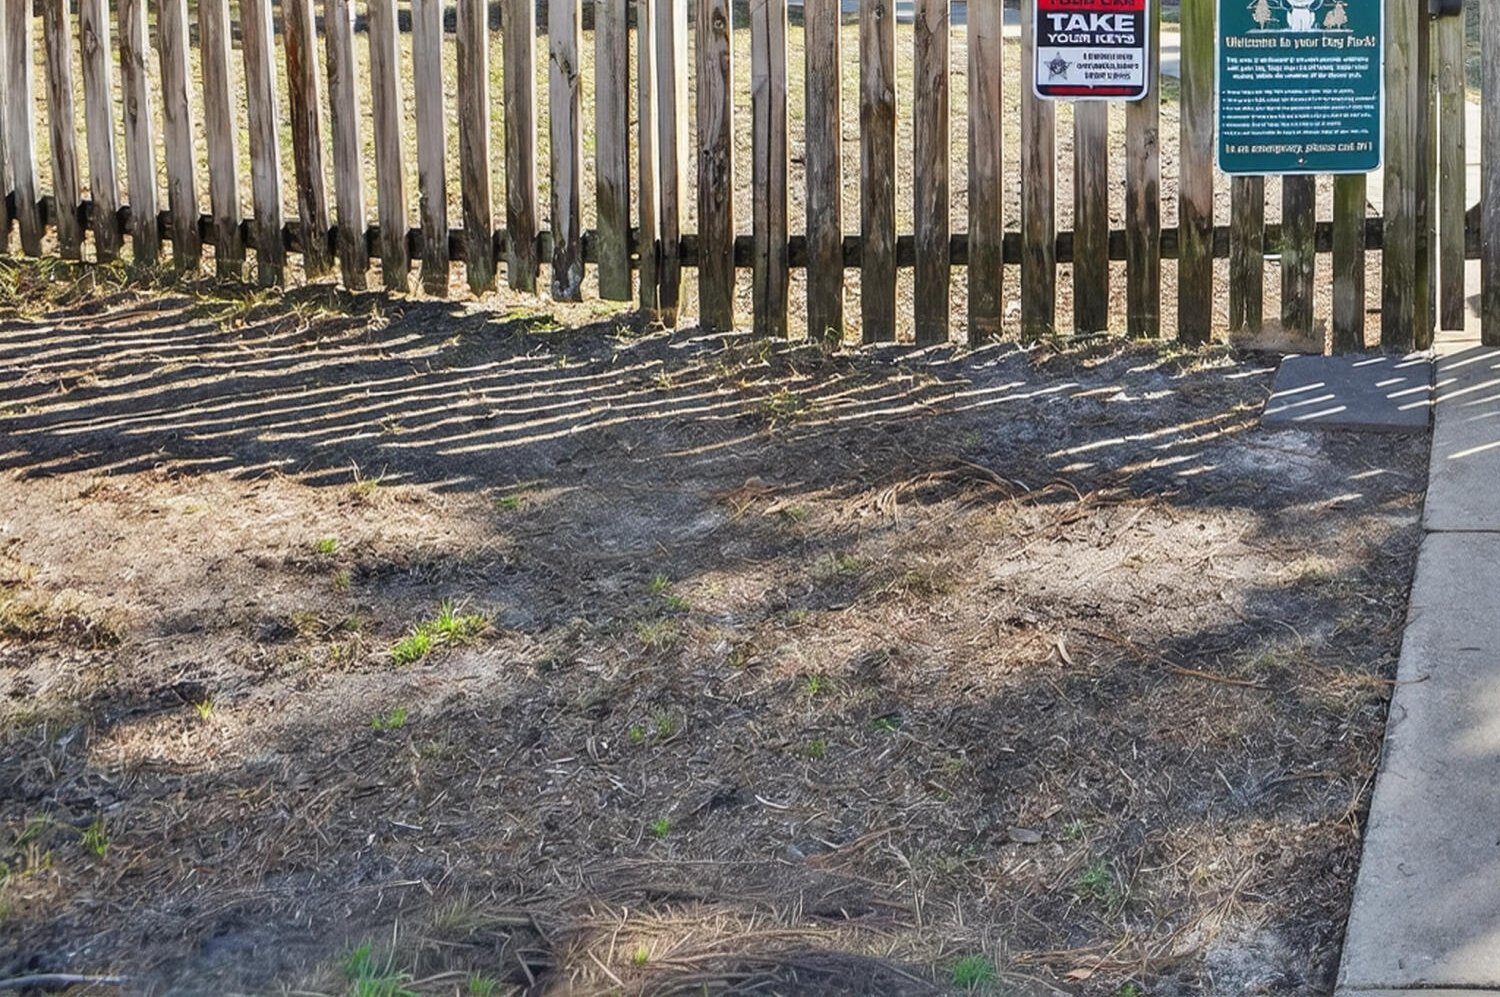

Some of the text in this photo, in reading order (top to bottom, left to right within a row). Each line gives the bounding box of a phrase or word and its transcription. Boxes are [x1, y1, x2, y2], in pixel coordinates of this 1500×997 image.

[1047, 13, 1135, 32] TAKE
[1047, 33, 1135, 44] YOUR KEYS
[1225, 36, 1277, 48] Welcome
[1279, 36, 1292, 47] to
[1294, 37, 1319, 49] your
[1322, 36, 1344, 49] Dog
